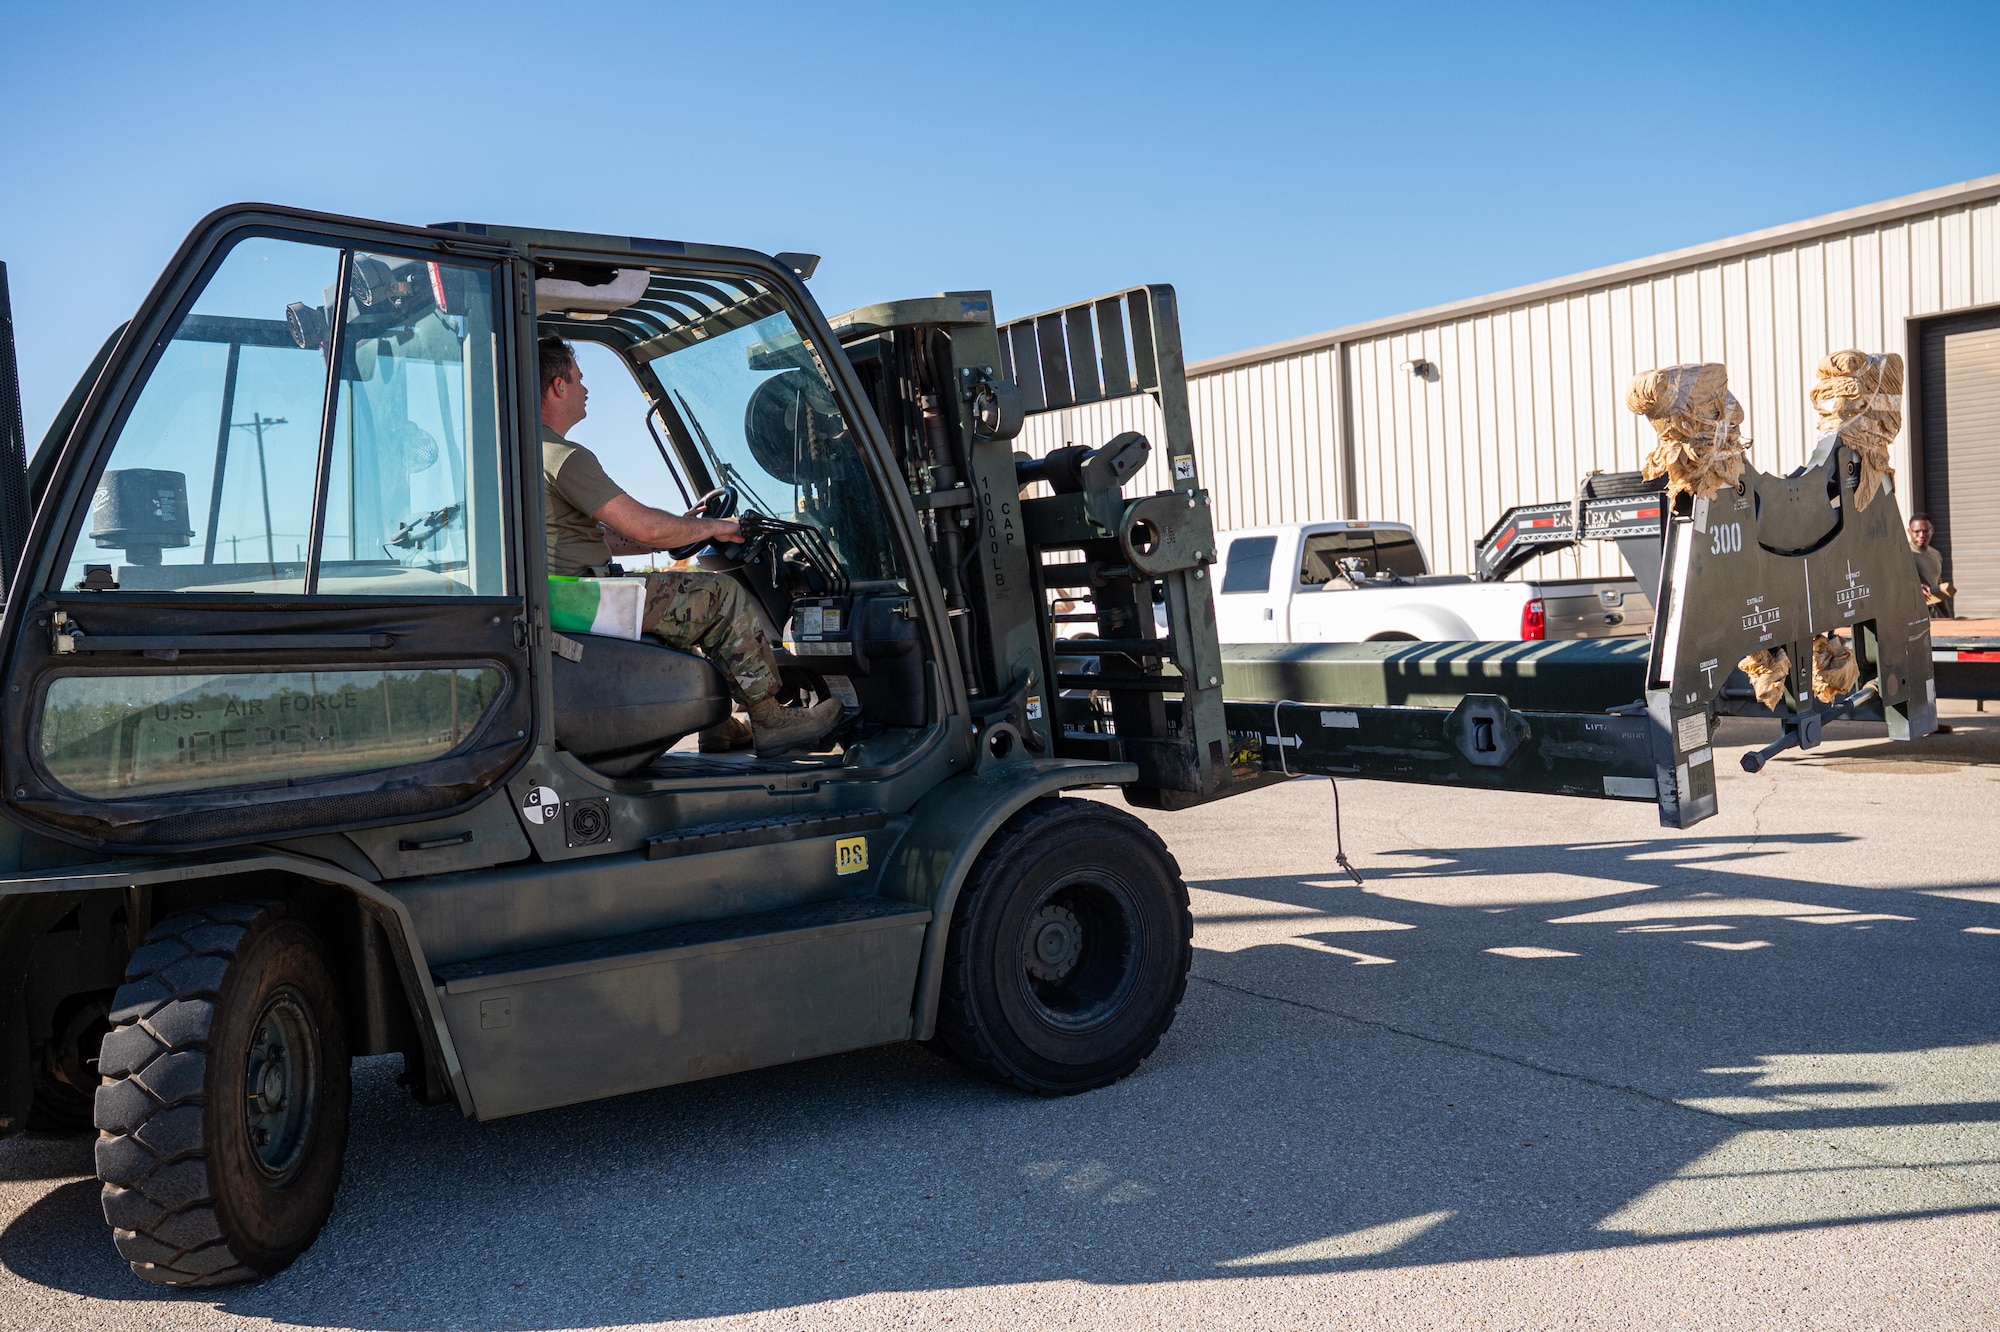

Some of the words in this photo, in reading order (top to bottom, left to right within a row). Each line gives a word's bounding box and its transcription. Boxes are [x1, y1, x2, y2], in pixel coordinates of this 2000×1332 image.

[1001, 502, 1014, 545] CAP
[1553, 512, 1578, 528] EAS
[1585, 510, 1622, 525] TEXAS
[1709, 521, 1742, 555] 300
[1746, 595, 1764, 606] EXTRACT
[1836, 590, 1854, 602] LOAD
[1858, 587, 1870, 597] PIN
[1743, 614, 1763, 628] LOAD
[1767, 610, 1780, 621] PIN
[1843, 609, 1856, 619] INSERT
[1759, 632, 1773, 642] INSERT
[155, 702, 202, 722] U.S.
[224, 699, 265, 718] AIR
[279, 692, 358, 714] FORCE
[840, 844, 862, 867] DS
